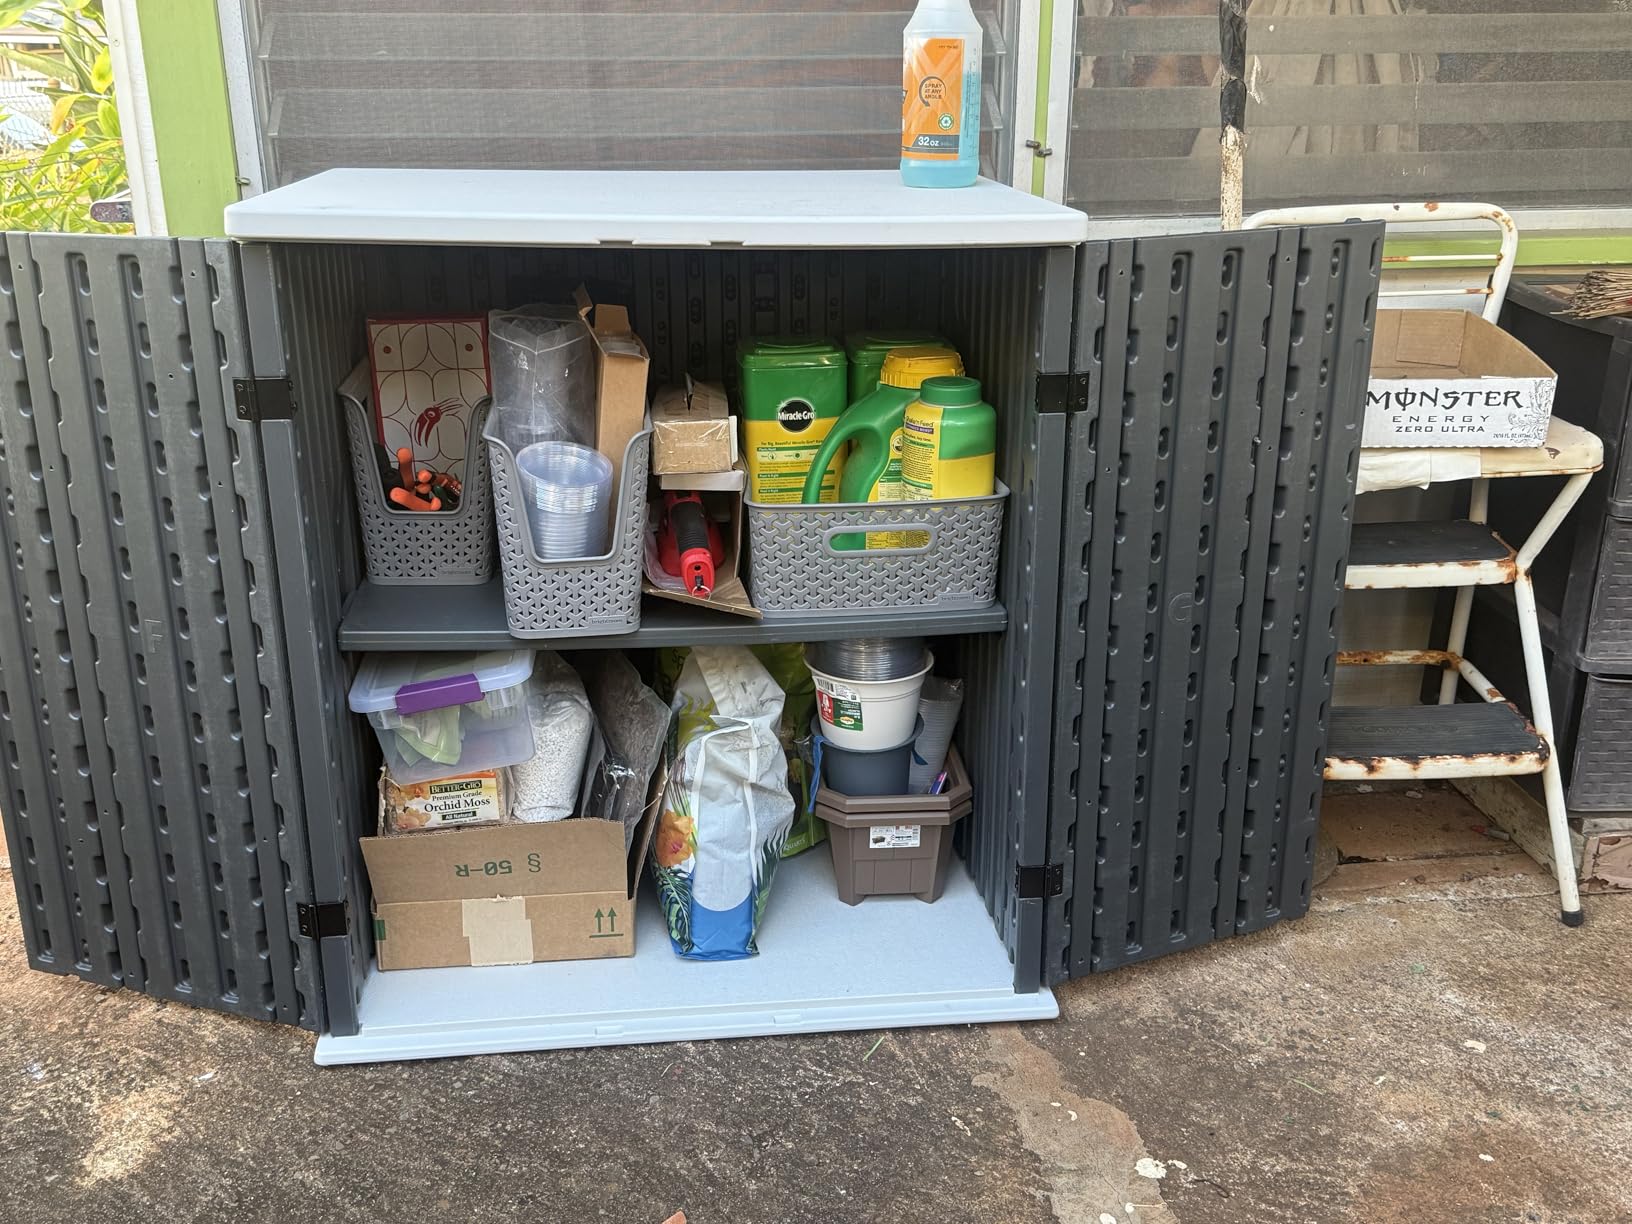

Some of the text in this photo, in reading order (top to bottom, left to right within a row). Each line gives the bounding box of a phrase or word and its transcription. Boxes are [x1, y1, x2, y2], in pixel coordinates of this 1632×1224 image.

[918, 136, 930, 146] 32
[1366, 387, 1524, 411] MONSTER
[1392, 415, 1491, 423] ENERGY
[1395, 425, 1486, 433] ZERO ULTRA
[431, 781, 481, 794] BETTER-GRO
[432, 790, 482, 802] Premium Grade
[424, 800, 461, 813] Orchid
[464, 798, 491, 809] Moss
[455, 859, 513, 878] 50-R
